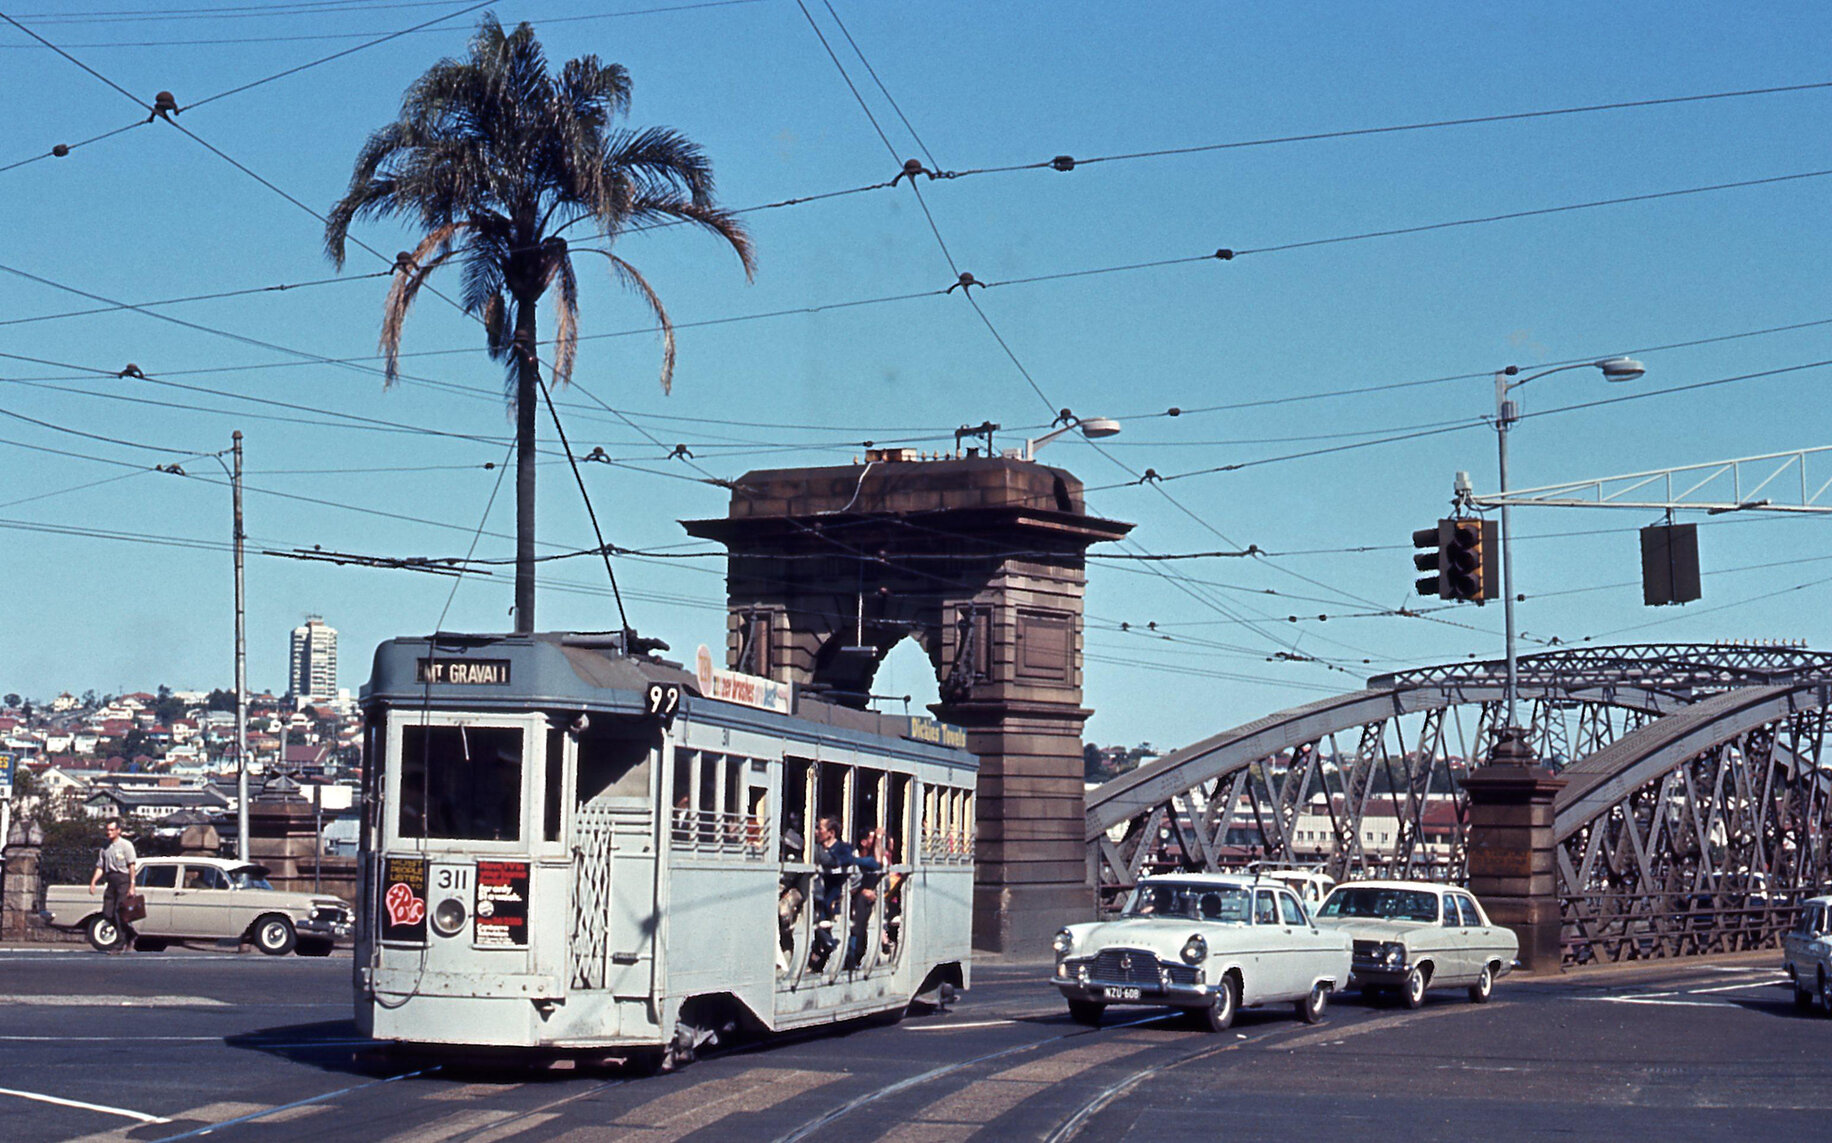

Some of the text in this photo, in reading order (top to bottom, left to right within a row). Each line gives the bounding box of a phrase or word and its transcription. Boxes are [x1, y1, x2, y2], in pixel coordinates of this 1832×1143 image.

[650, 685, 678, 713] 99
[911, 716, 966, 748] Dickies Towels
[390, 866, 424, 874] PEOPLE
[390, 873, 423, 881] LISTEN
[438, 869, 467, 889] 311
